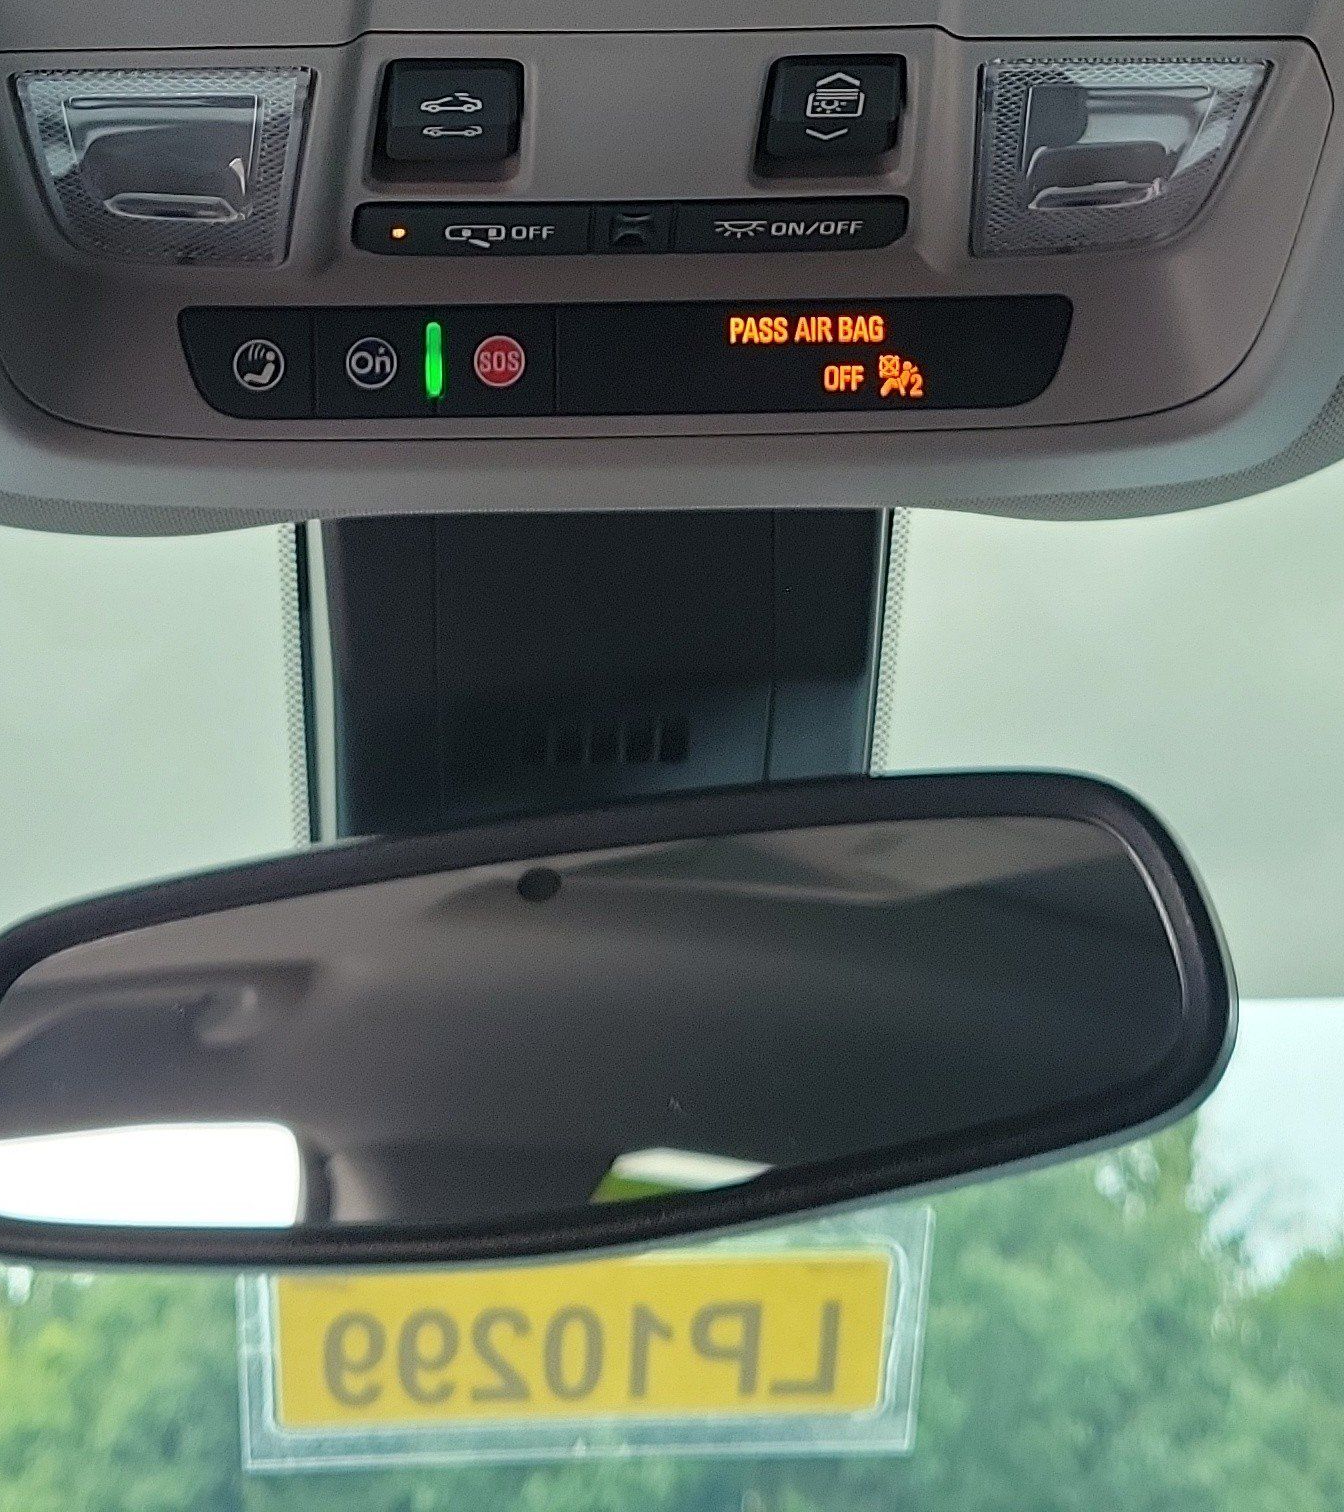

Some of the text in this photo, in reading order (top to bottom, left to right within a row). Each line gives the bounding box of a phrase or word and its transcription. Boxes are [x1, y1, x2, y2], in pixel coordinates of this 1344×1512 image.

[510, 225, 556, 241] OFF
[771, 220, 864, 236] ON/OFF
[729, 315, 884, 344] PASS AIR BAG
[478, 350, 520, 373] SOS
[824, 365, 864, 392] OFF
